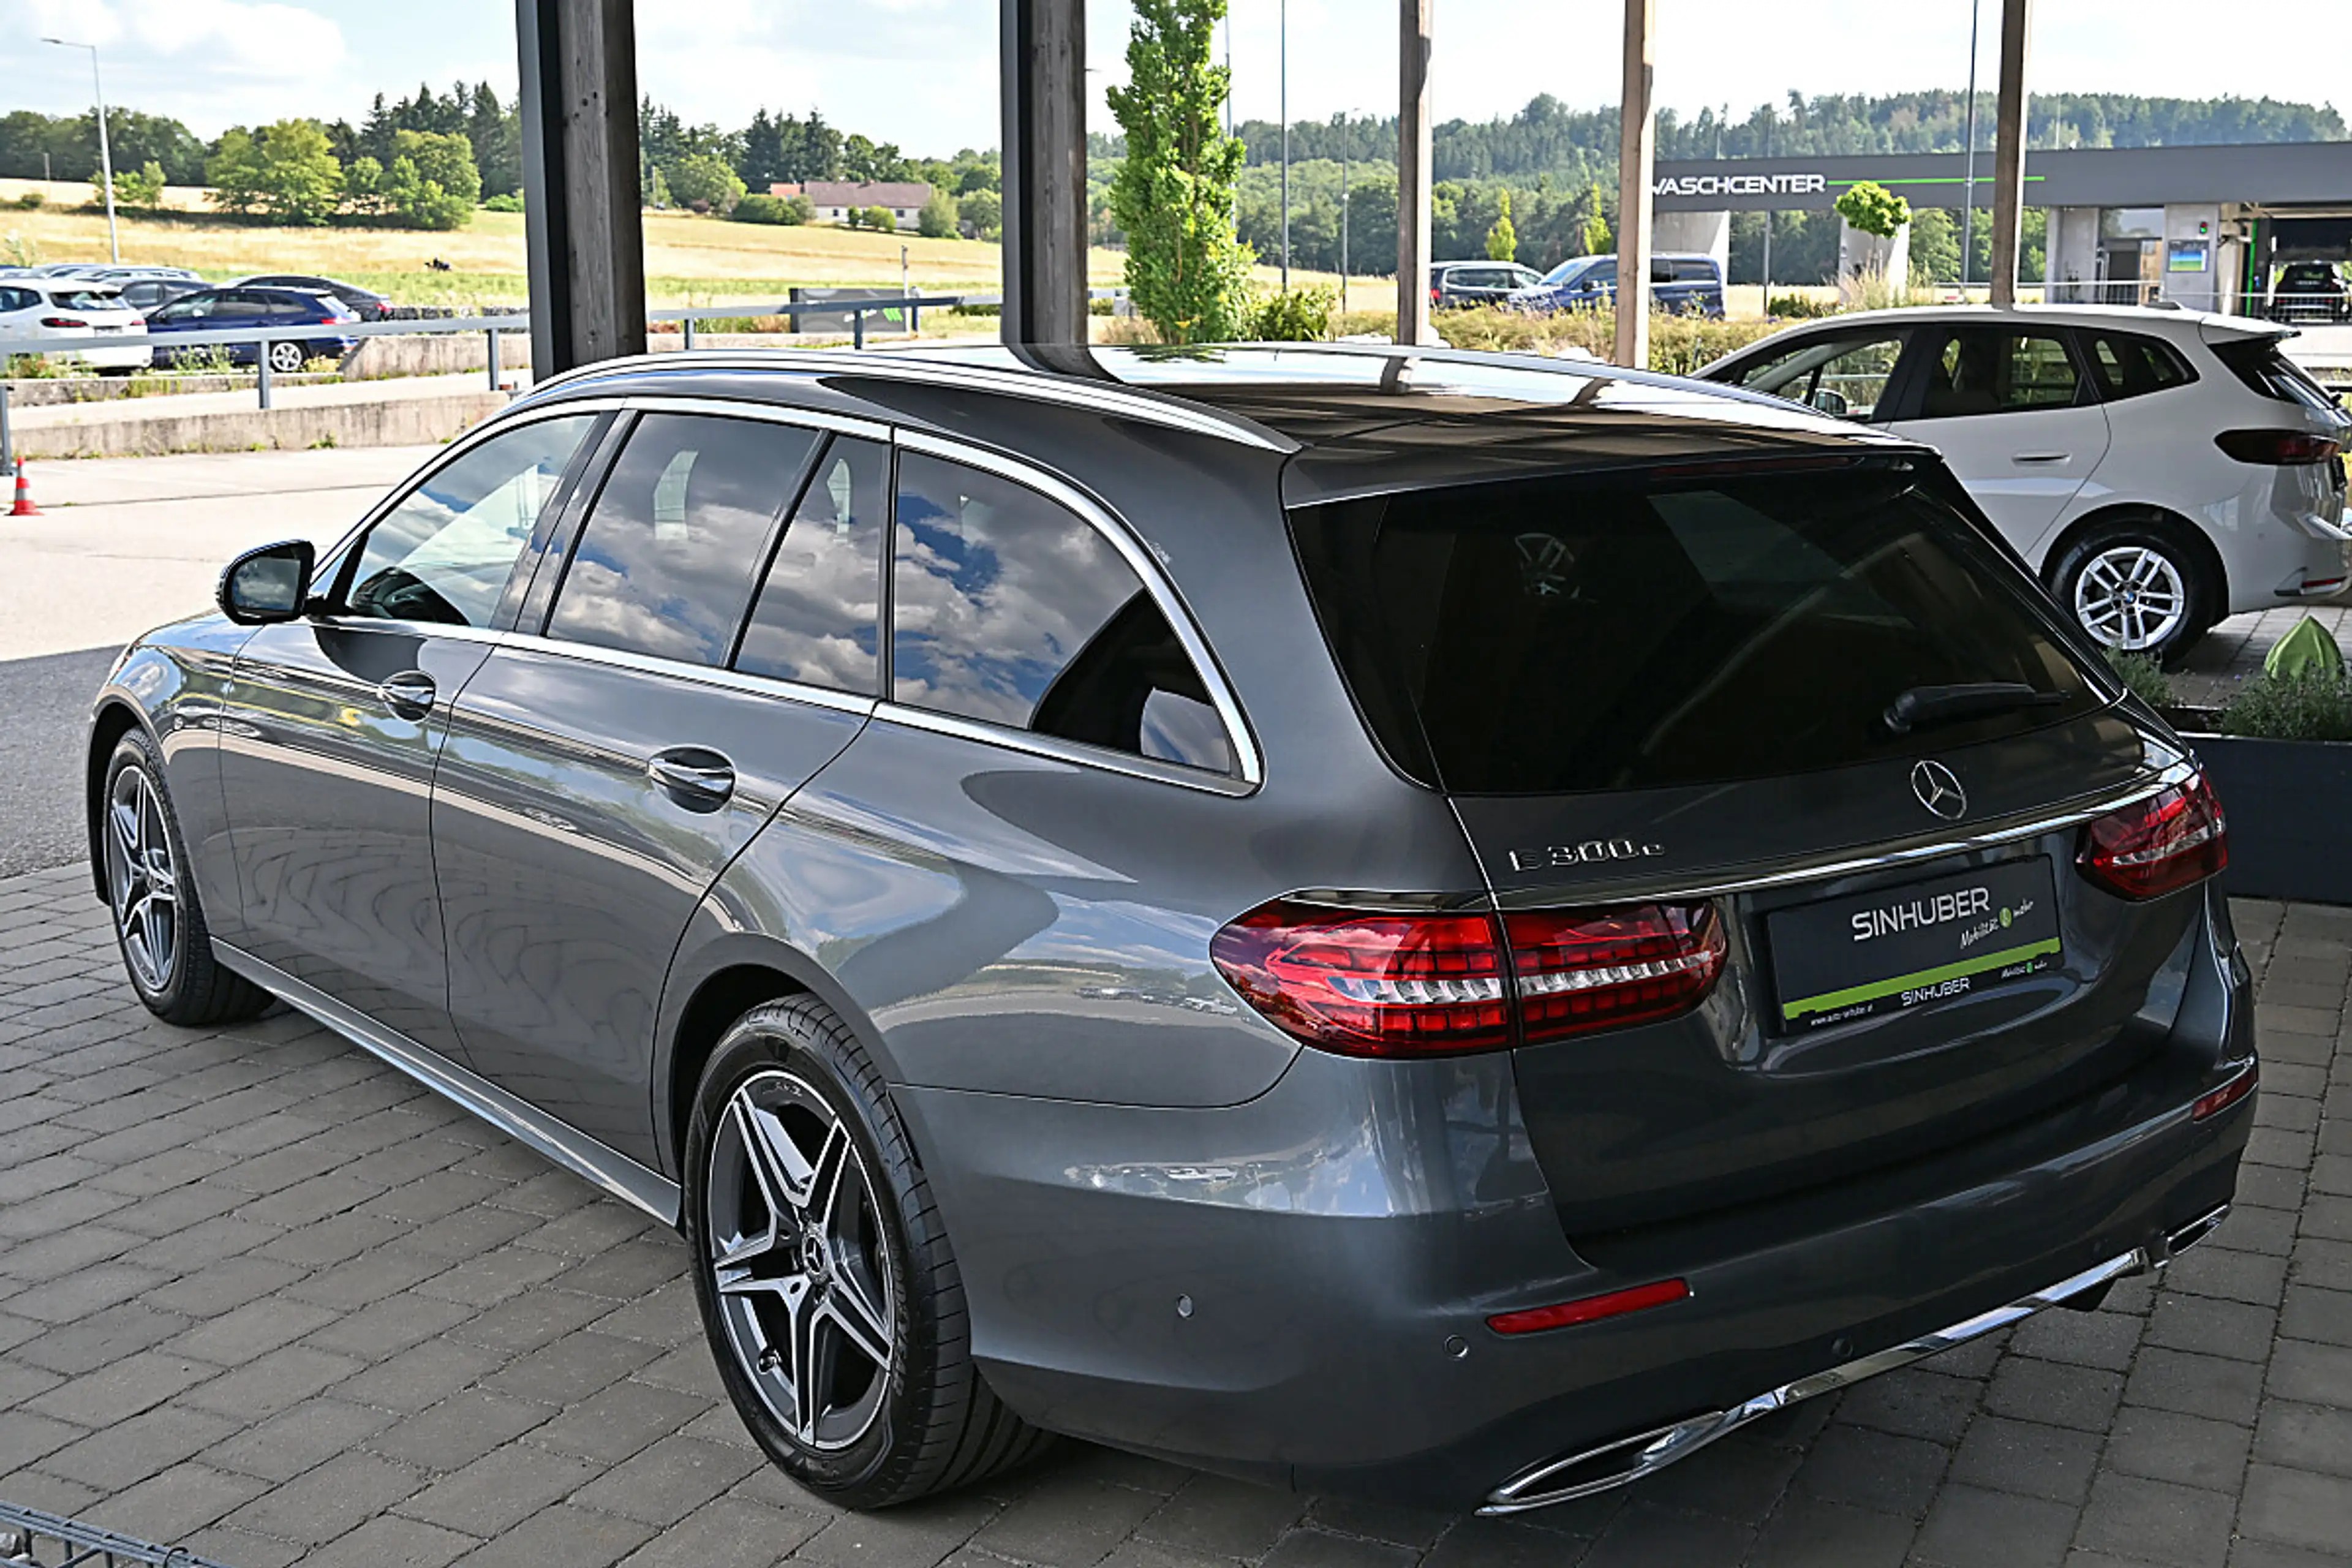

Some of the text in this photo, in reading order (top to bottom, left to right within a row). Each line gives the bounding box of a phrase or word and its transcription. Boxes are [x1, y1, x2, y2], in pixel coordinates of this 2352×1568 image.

[1509, 839, 1665, 871] E 300 e
[1852, 887, 1991, 941] SINHUBER
[1901, 977, 1971, 1006] SINHUBER
